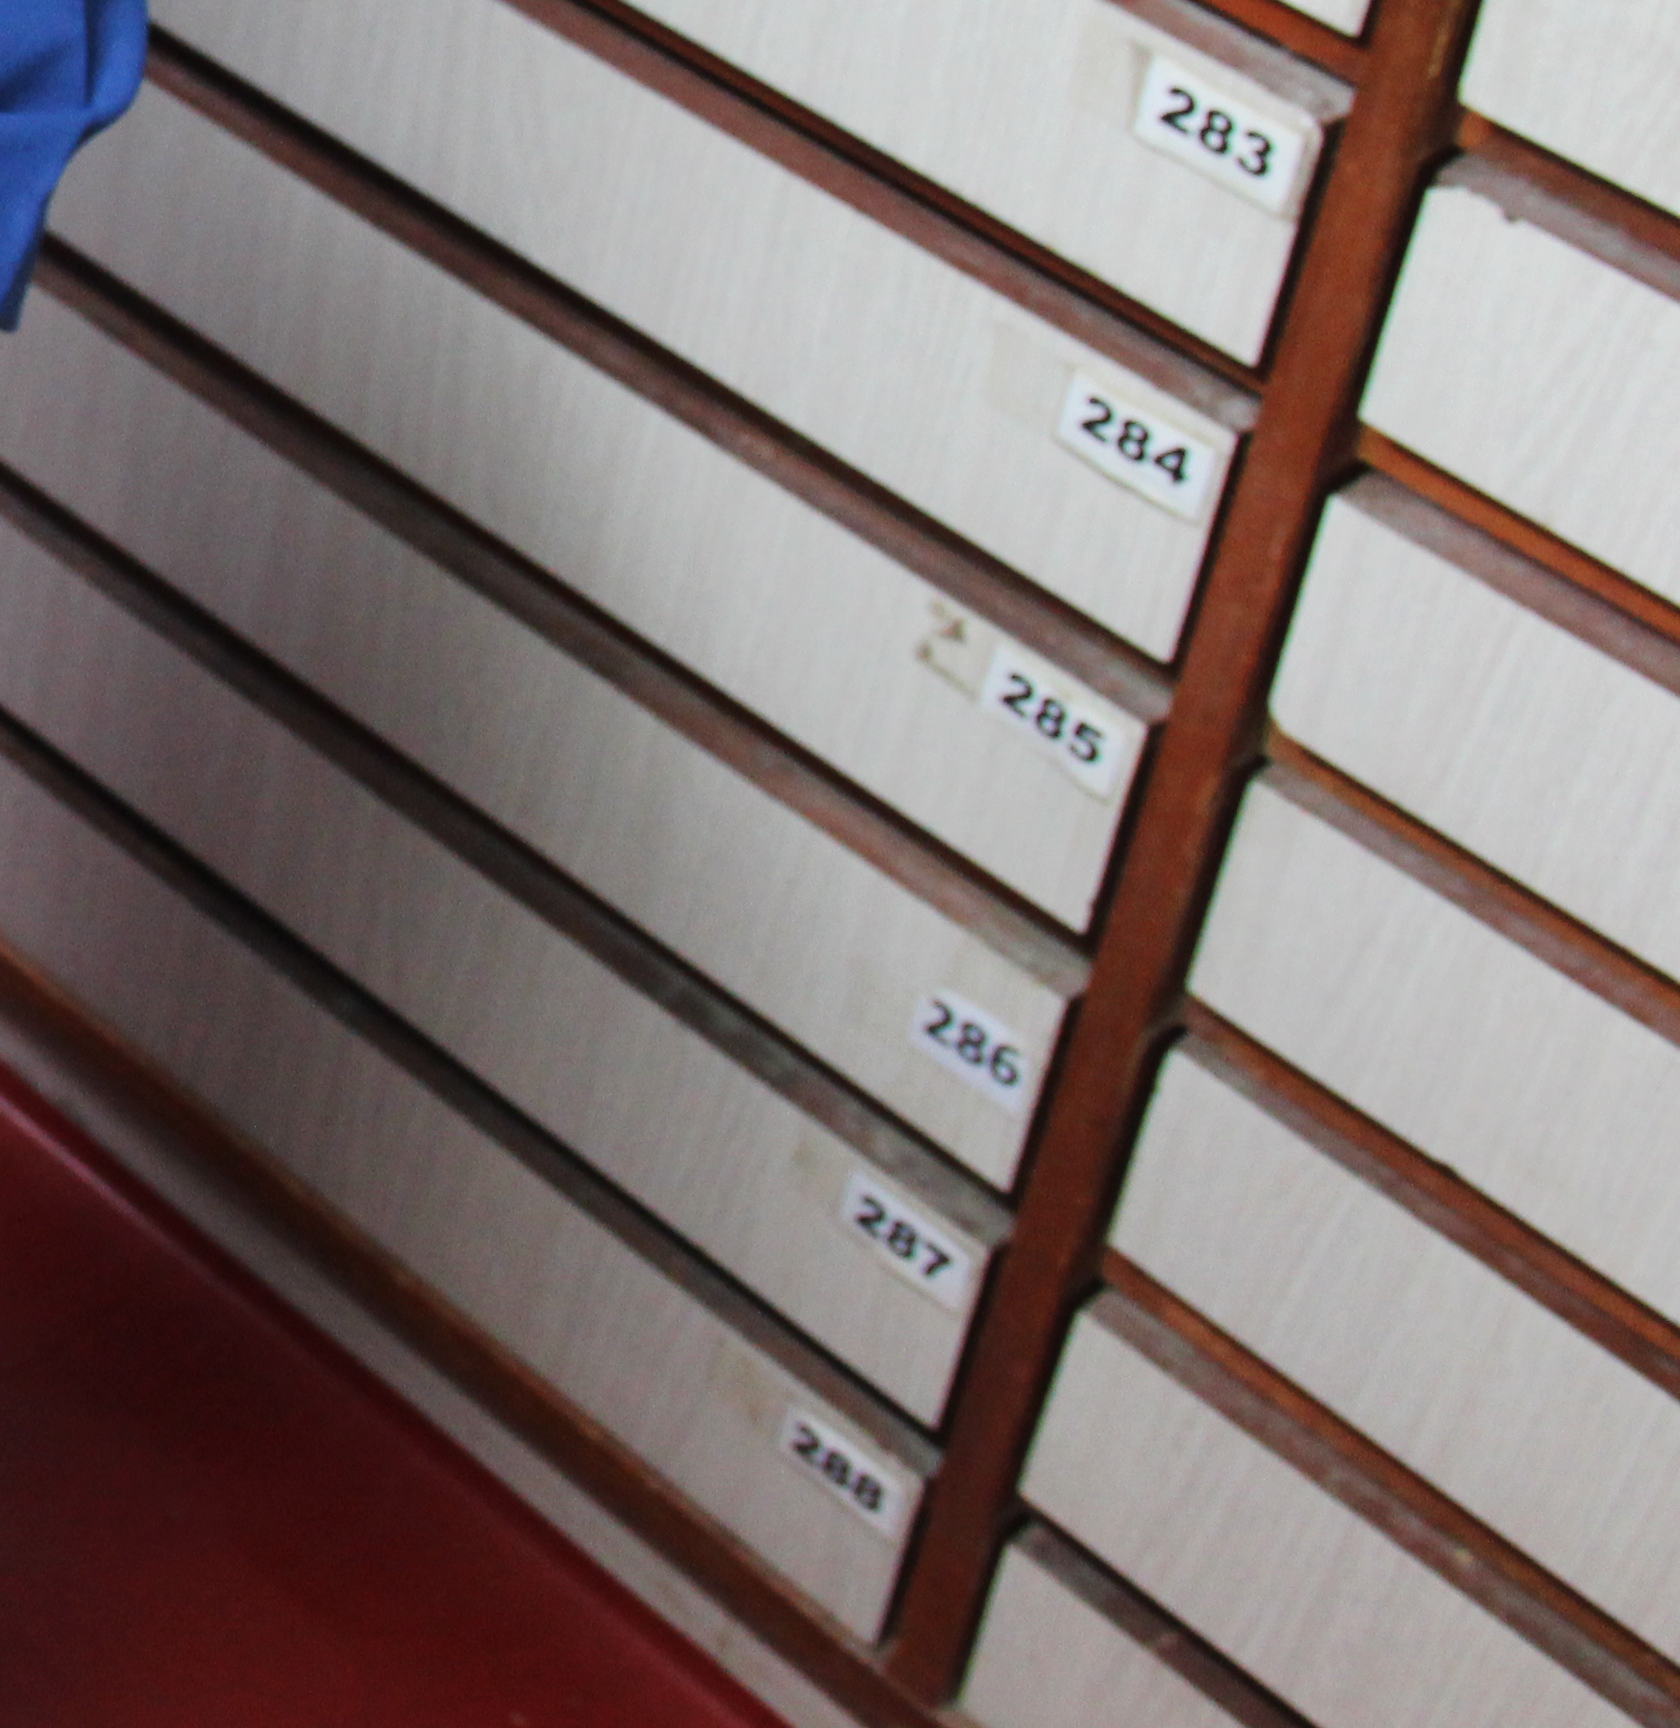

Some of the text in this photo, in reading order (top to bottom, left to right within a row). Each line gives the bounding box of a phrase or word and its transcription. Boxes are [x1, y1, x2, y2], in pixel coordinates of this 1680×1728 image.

[1160, 86, 1274, 179] 283
[1081, 396, 1192, 485] 284
[999, 673, 1104, 766] 285
[924, 1001, 1019, 1086] 286
[855, 1195, 952, 1278] 287
[790, 1421, 884, 1514] 288
